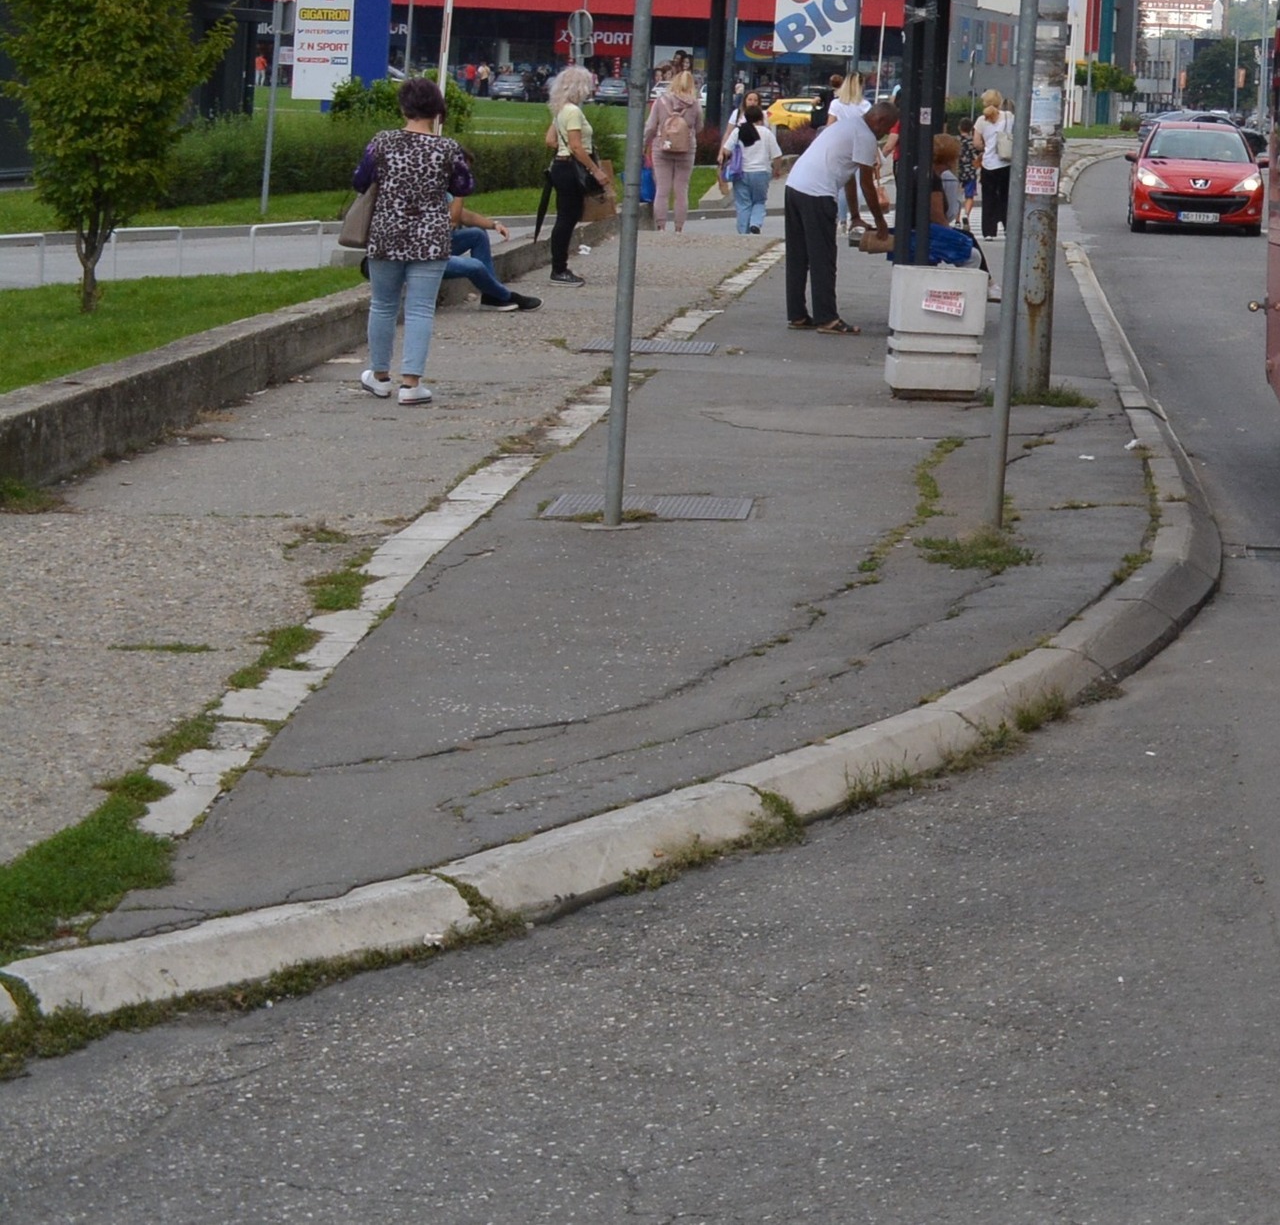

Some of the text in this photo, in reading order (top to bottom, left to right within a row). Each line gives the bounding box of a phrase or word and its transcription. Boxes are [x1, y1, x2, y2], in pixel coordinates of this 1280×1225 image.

[299, 8, 350, 21] GIGATRON
[316, 42, 350, 52] SPORT
[821, 44, 829, 52] 10
[841, 45, 853, 53] 22
